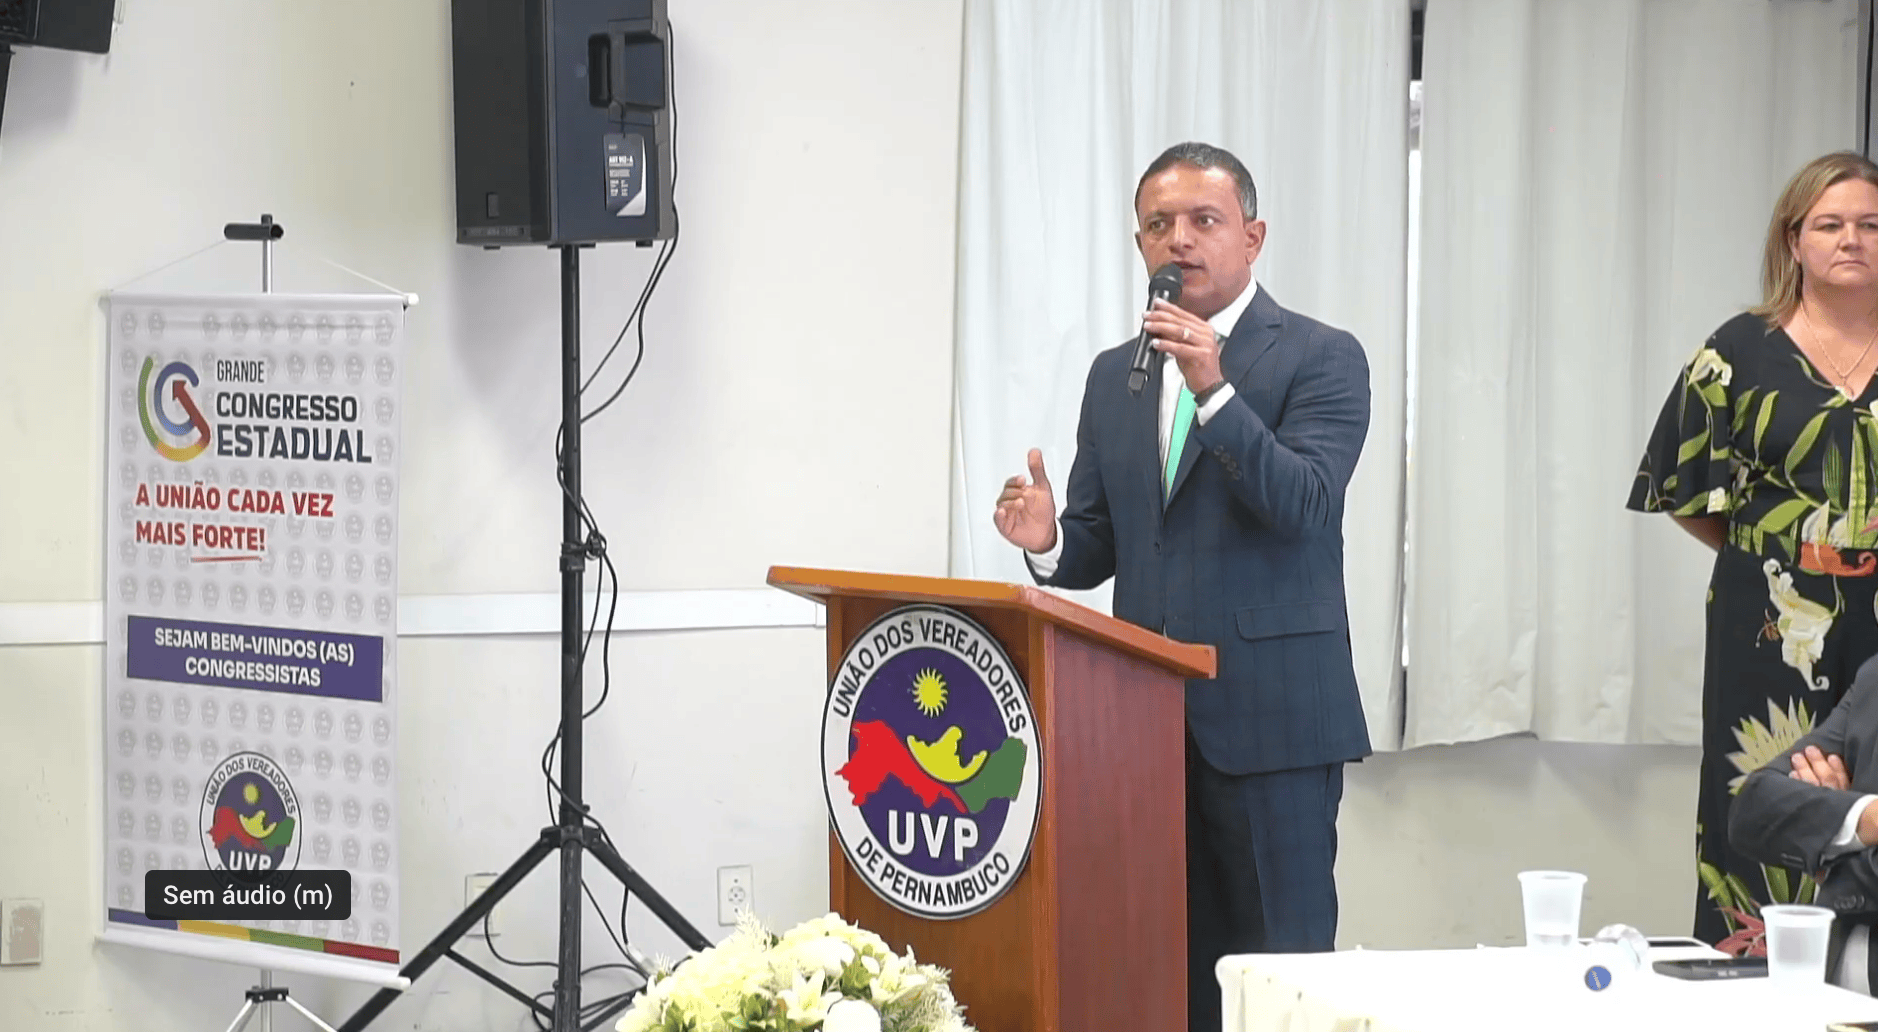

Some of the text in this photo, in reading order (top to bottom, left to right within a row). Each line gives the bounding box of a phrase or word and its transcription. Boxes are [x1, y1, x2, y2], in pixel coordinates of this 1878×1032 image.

[216, 360, 265, 383] GRANDE
[216, 391, 358, 422] CONGRESSO
[216, 424, 373, 463] ESTADUAL
[135, 480, 334, 517] A UNIÃO CADA VEZ
[135, 520, 266, 551] MAIS FORTE!
[154, 627, 355, 667] SEJAM BEM-VINDOS (AS)
[185, 657, 321, 687] CONGRESSISTAS
[833, 617, 1027, 734] UNIÃO DOS VEREADORES
[225, 757, 245, 775] DOS
[247, 757, 295, 815] VEREADORES
[888, 809, 979, 862] UVP
[229, 850, 272, 872] UVP
[855, 836, 1010, 907] DE PERNAMBUCO
